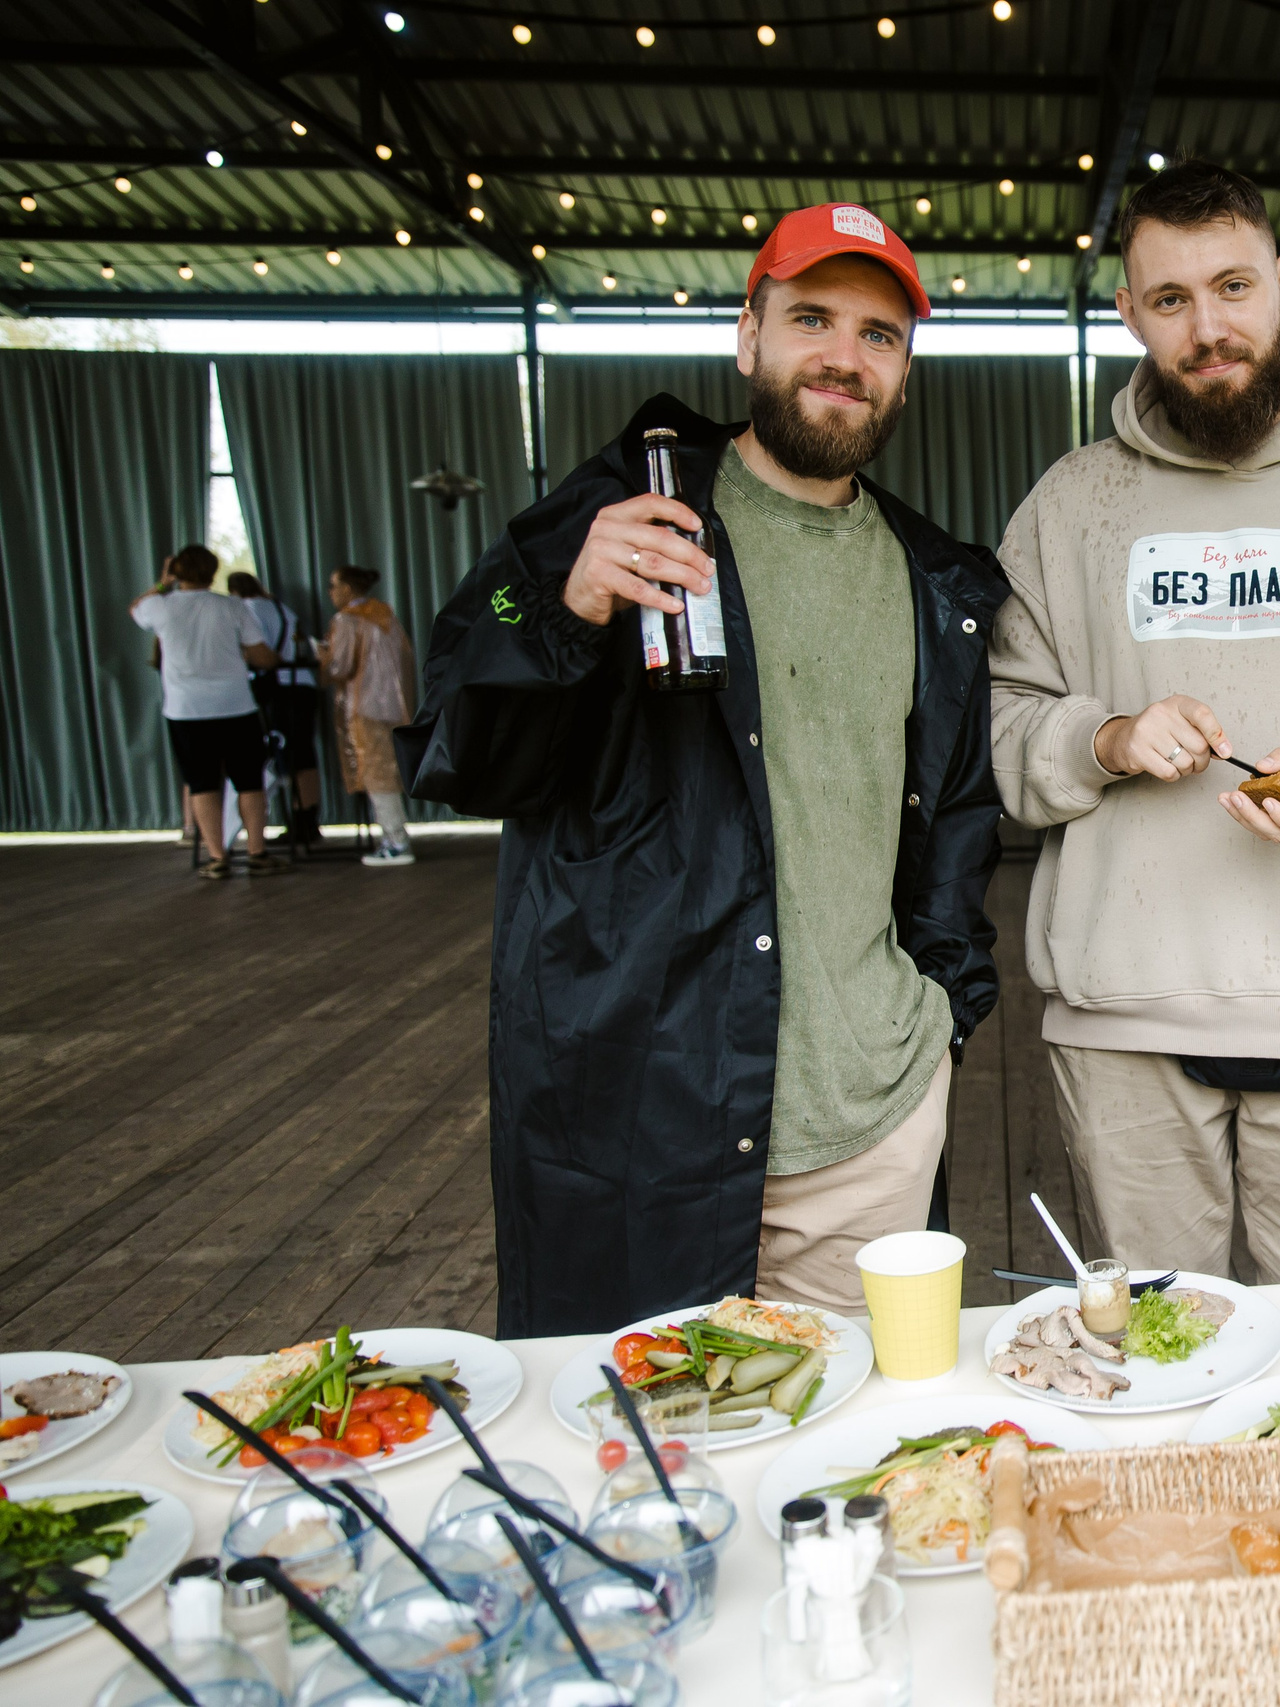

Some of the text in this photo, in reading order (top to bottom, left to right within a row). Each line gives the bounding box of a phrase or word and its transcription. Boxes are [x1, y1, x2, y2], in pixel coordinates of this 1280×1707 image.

[837, 215, 882, 235] NEW ERA
[1203, 546, 1267, 569] Без цели
[1153, 571, 1208, 605] БЕЗ
[1168, 609, 1180, 621] Без
